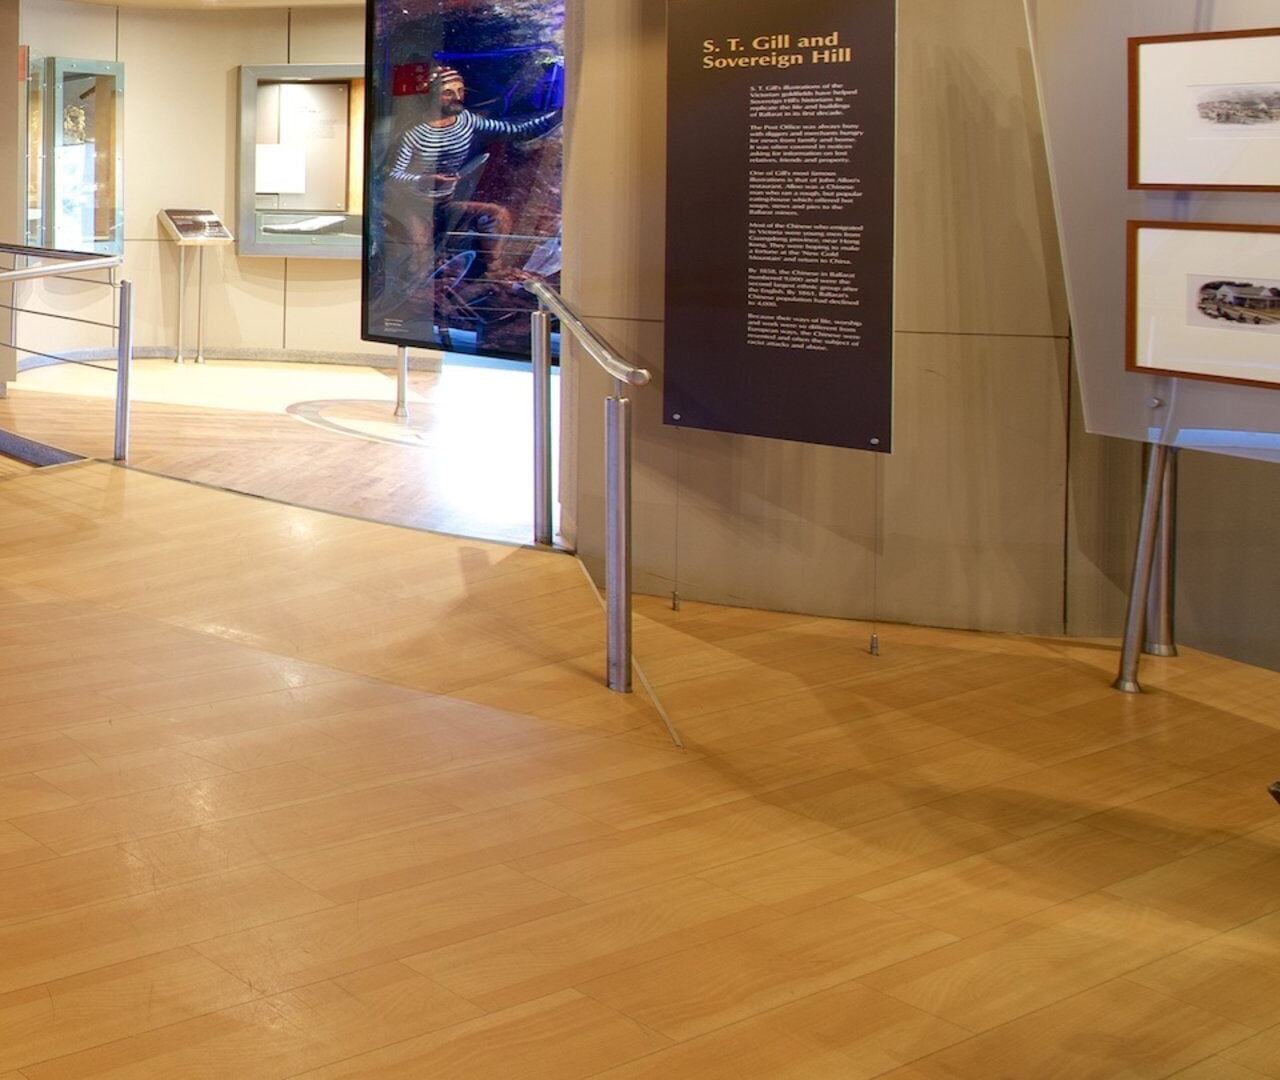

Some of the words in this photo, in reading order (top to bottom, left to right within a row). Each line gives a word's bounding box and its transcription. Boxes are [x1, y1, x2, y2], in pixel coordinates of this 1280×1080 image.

[703, 40, 720, 53] S.
[727, 38, 744, 51] T.
[752, 35, 790, 50] Gill
[797, 32, 839, 48] and
[703, 51, 804, 68] Sovereign
[812, 48, 851, 63] Hill
